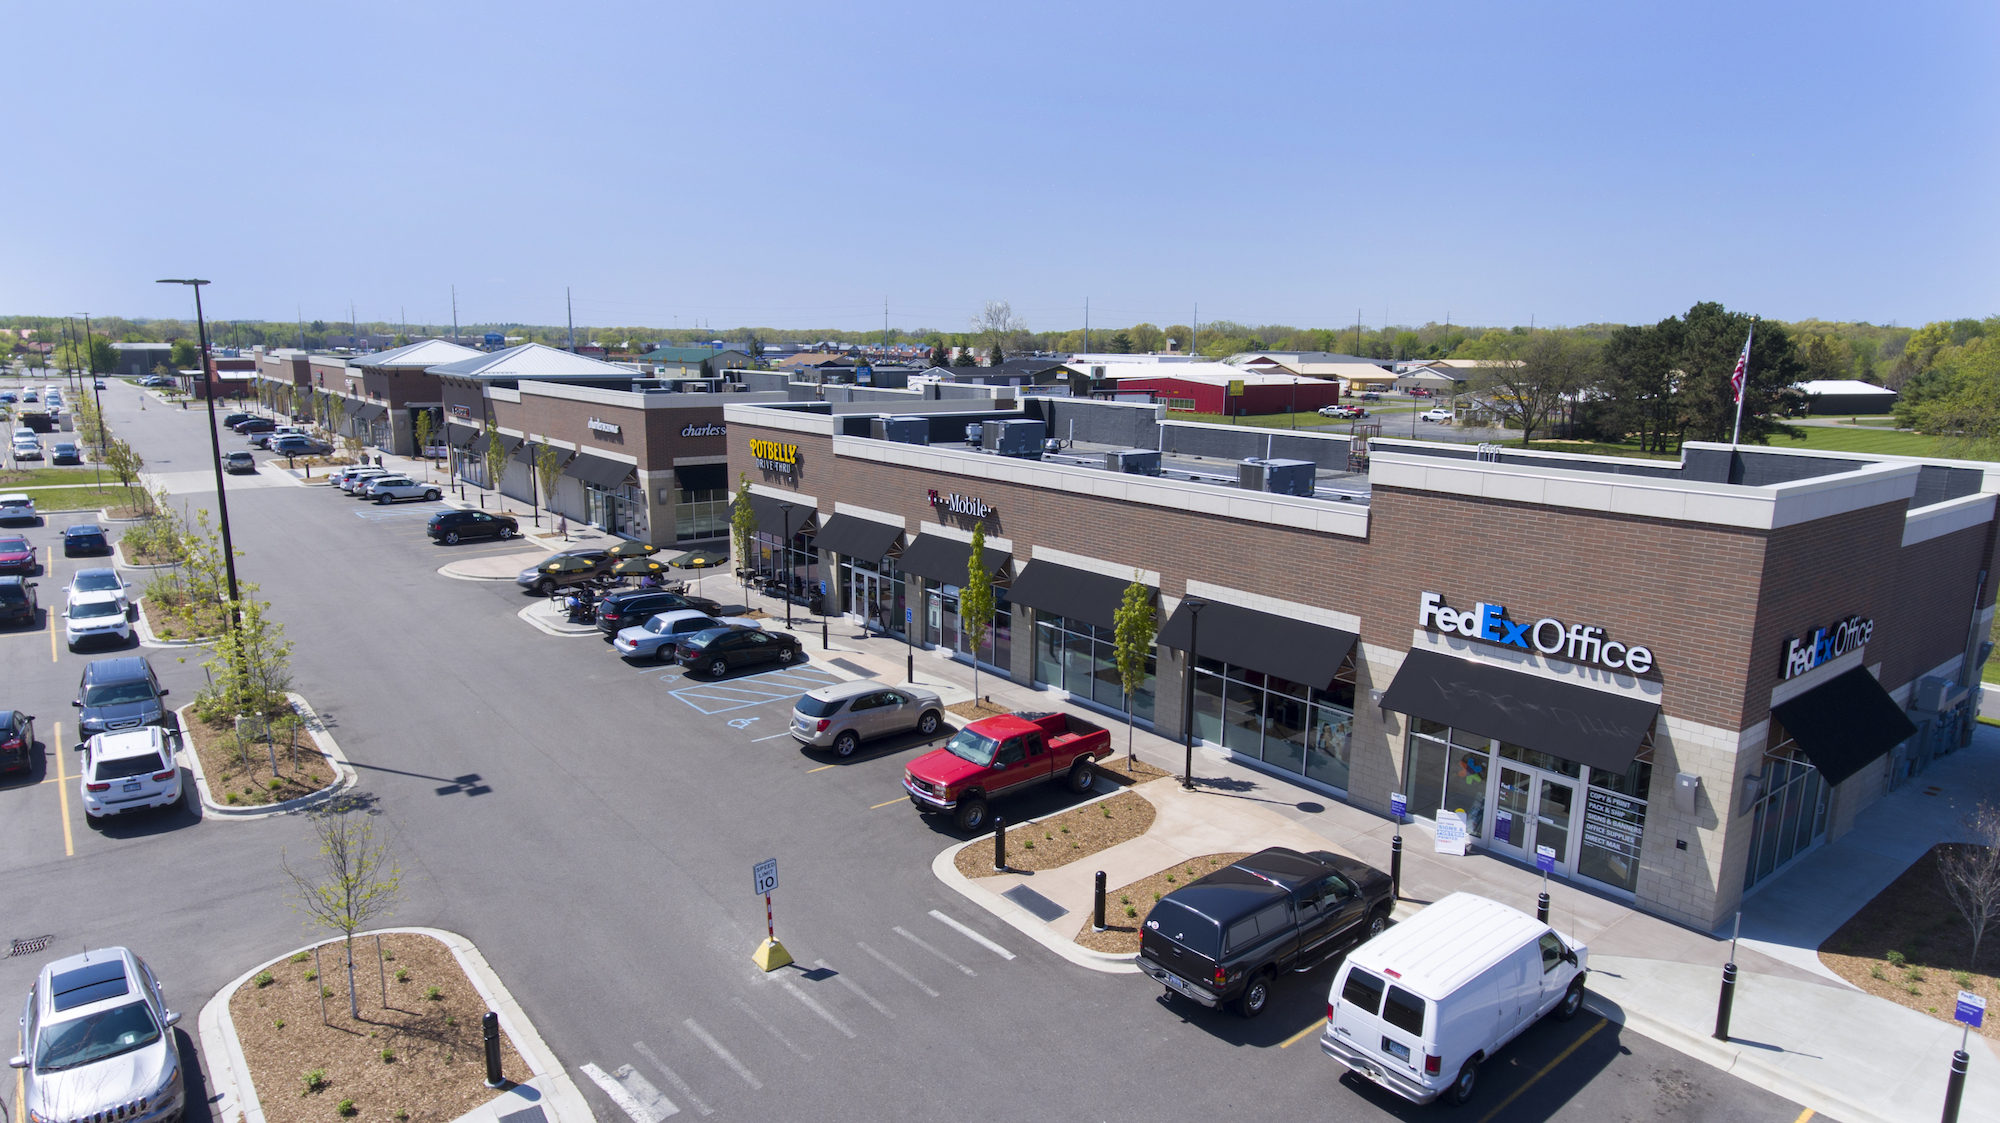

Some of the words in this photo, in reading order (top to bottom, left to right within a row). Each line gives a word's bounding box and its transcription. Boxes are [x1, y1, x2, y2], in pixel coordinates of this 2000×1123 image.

[681, 423, 721, 437] charles
[749, 438, 798, 464] POTBELLY
[756, 458, 773, 471] DRIVE
[774, 461, 791, 474] THRU
[1418, 591, 1532, 649] FedEx
[1532, 618, 1653, 674] Office
[1784, 627, 1836, 680] FedEx
[1834, 615, 1874, 657] Office
[1590, 791, 1606, 801] COPY
[1606, 796, 1612, 804] &
[1612, 798, 1631, 809] PRINT
[1589, 802, 1604, 812] PACK
[1611, 809, 1626, 818] SHIP
[1587, 813, 1606, 824] SIGNS
[1606, 818, 1612, 826] &
[1612, 820, 1643, 835] BANNERS
[1585, 833, 1606, 845] DIRECT
[1606, 840, 1622, 851] MAIL
[1586, 823, 1605, 835] OFFICE
[1606, 829, 1635, 844] SUPPLIES
[756, 862, 775, 873] SPEED
[758, 869, 774, 878] LIMIT
[759, 876, 774, 890] 10
